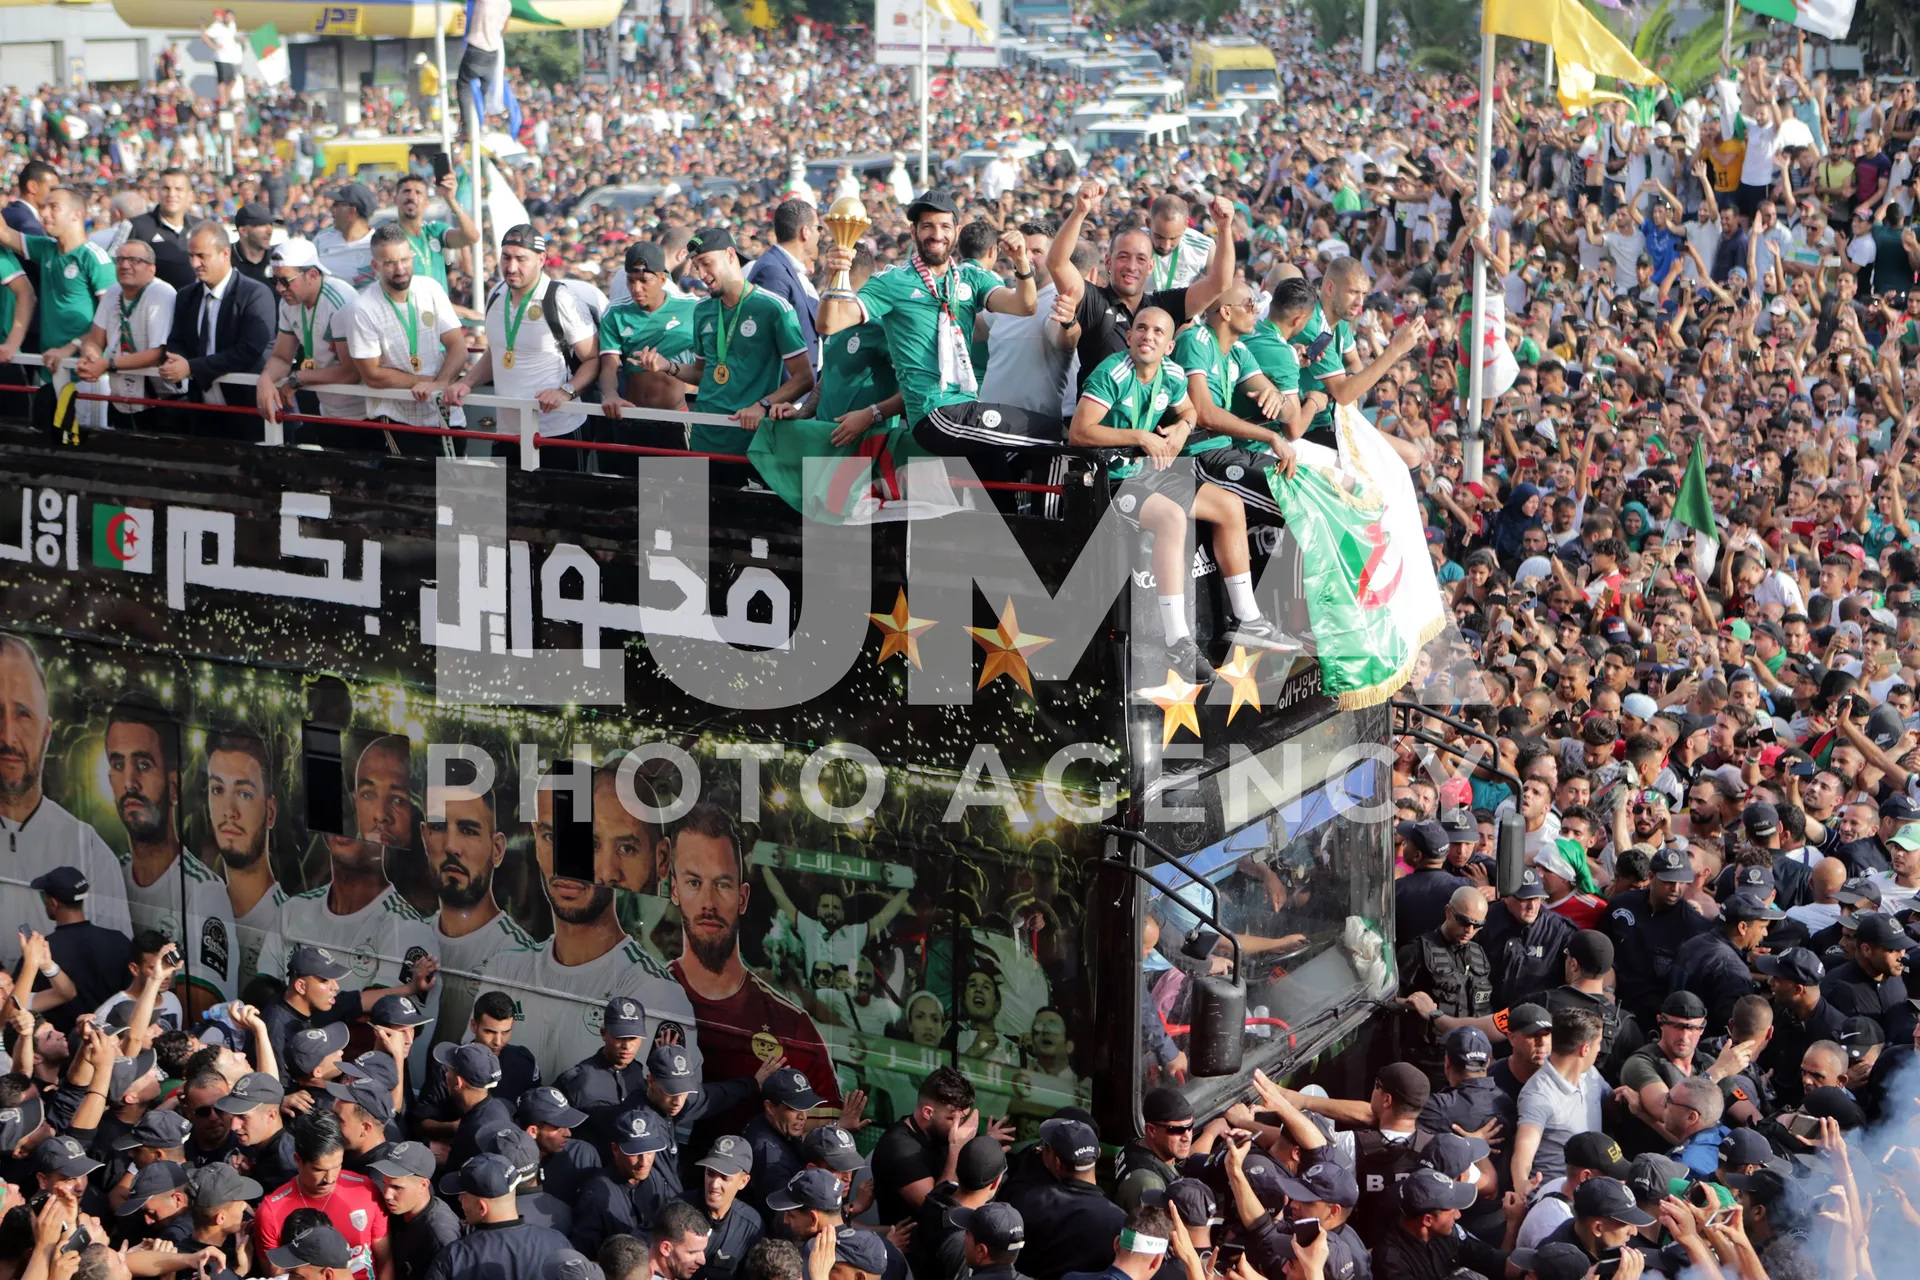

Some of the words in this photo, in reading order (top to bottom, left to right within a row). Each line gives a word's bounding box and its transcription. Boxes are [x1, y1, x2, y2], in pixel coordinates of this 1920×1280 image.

[167, 491, 381, 636] بكم
[1191, 562, 1217, 579] adidas
[796, 853, 870, 876] الجزائر
[1075, 1145, 1096, 1157] POLICE
